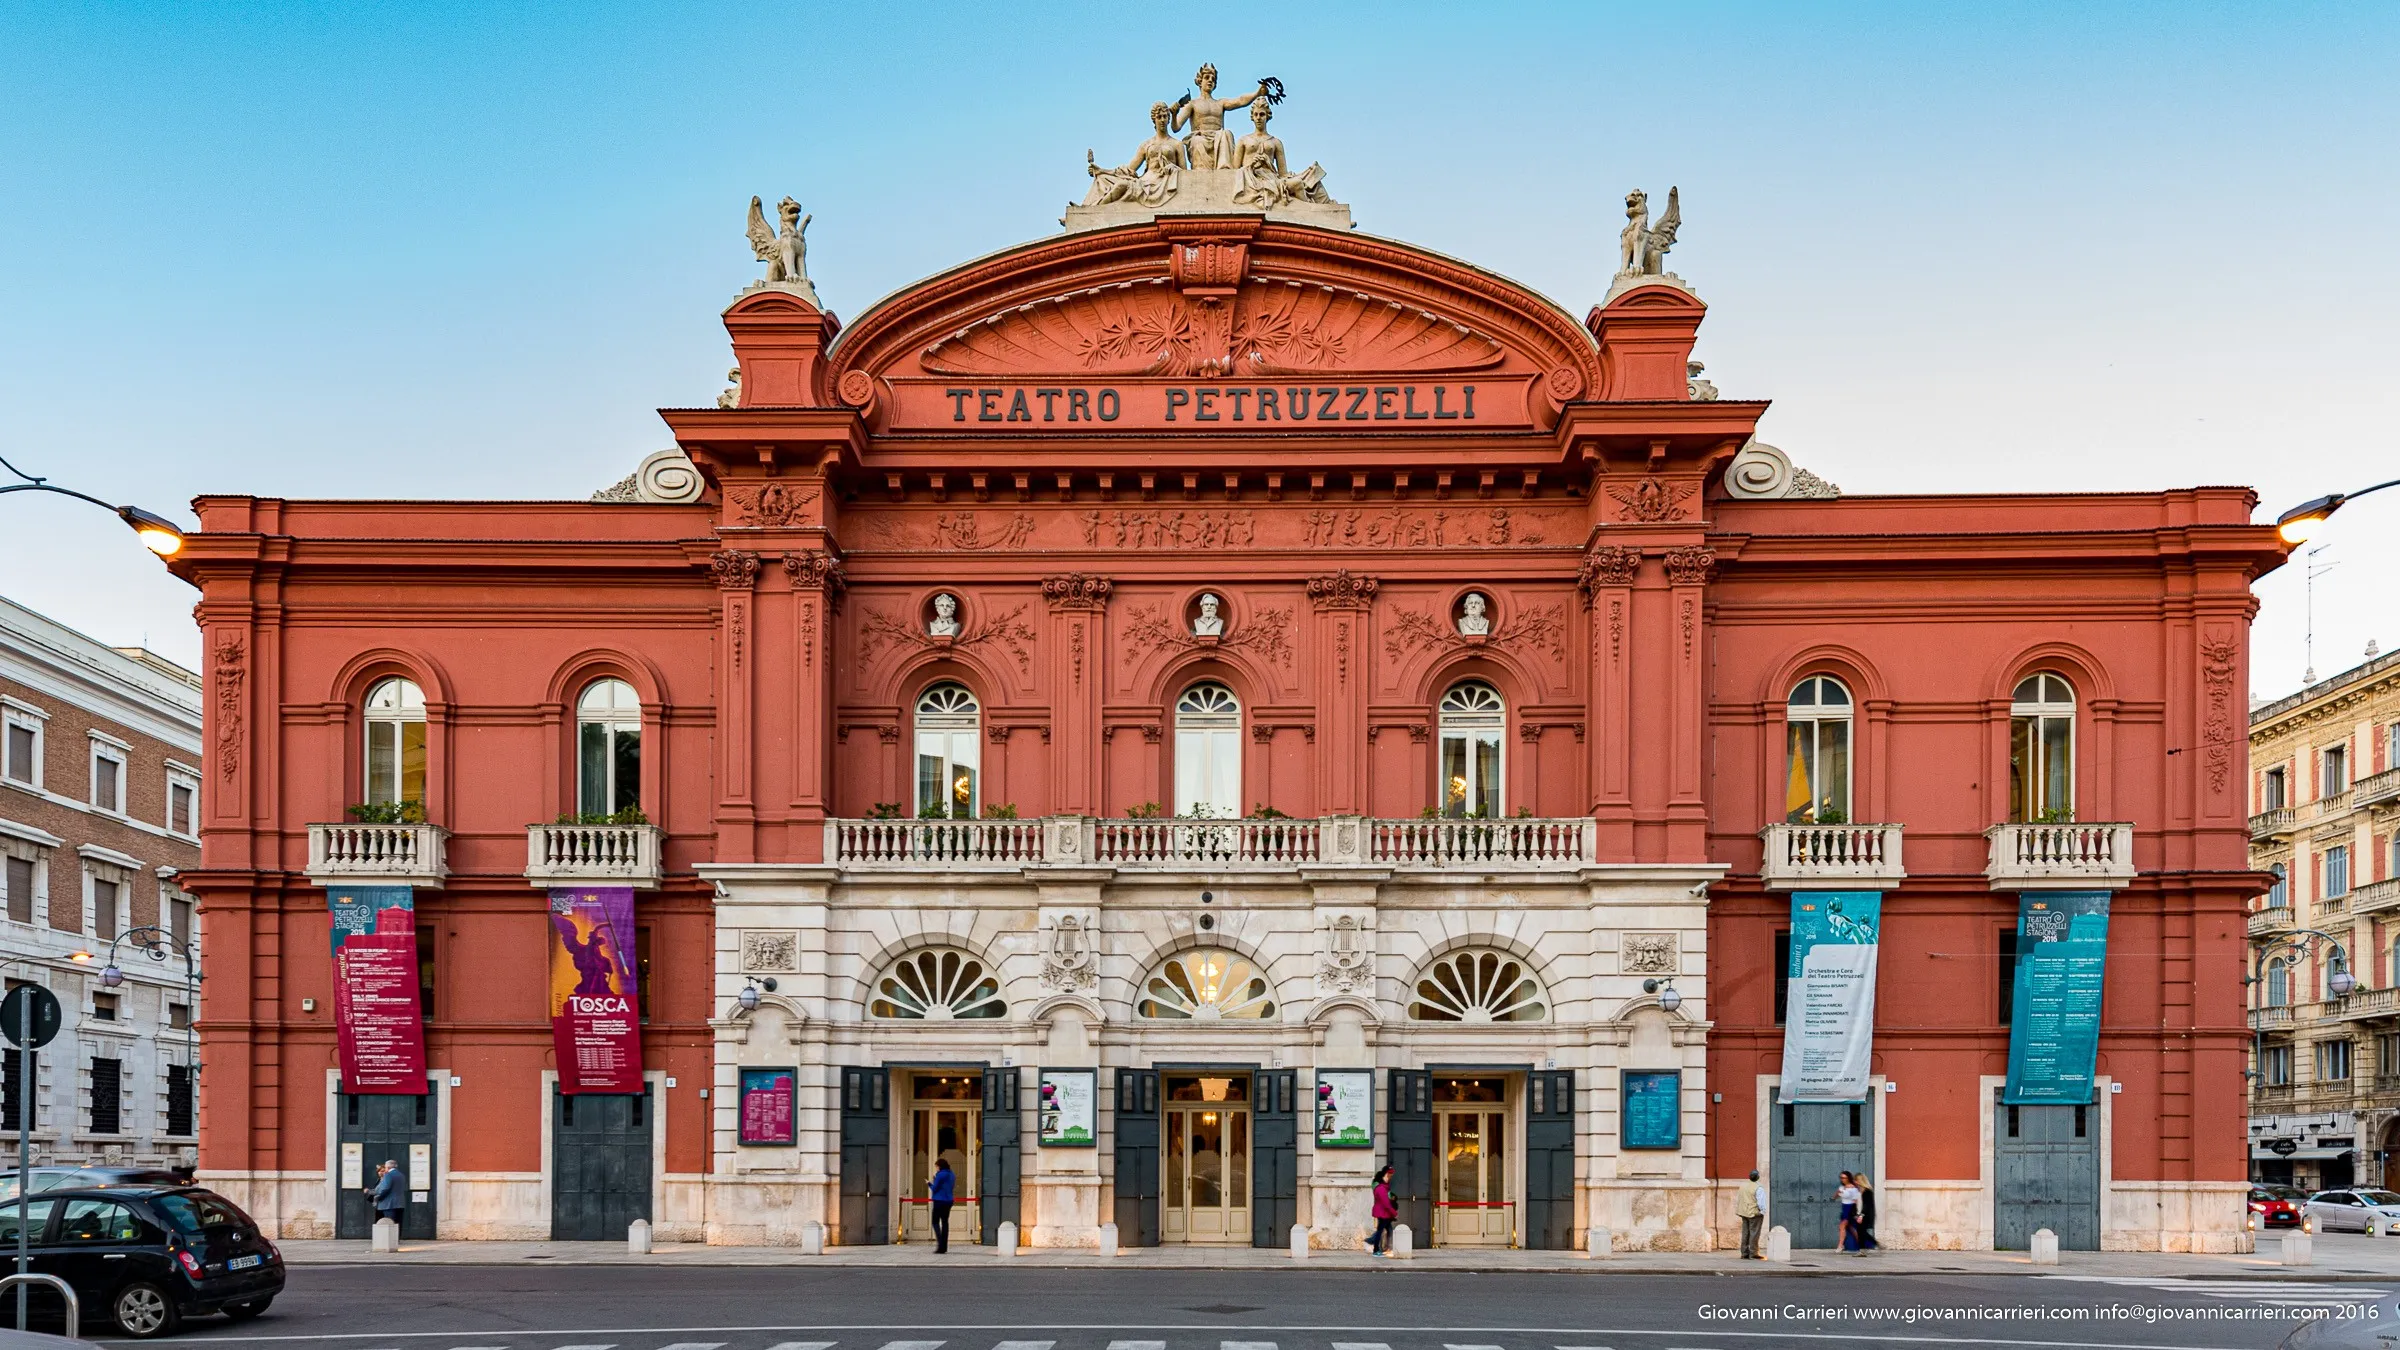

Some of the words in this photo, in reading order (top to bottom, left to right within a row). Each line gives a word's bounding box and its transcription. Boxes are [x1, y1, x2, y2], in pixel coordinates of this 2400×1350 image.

[946, 388, 1120, 421] TEATRO
[1166, 386, 1475, 420] PETRUZZELLI
[338, 954, 347, 978] musical
[569, 996, 630, 1012] TOSCA
